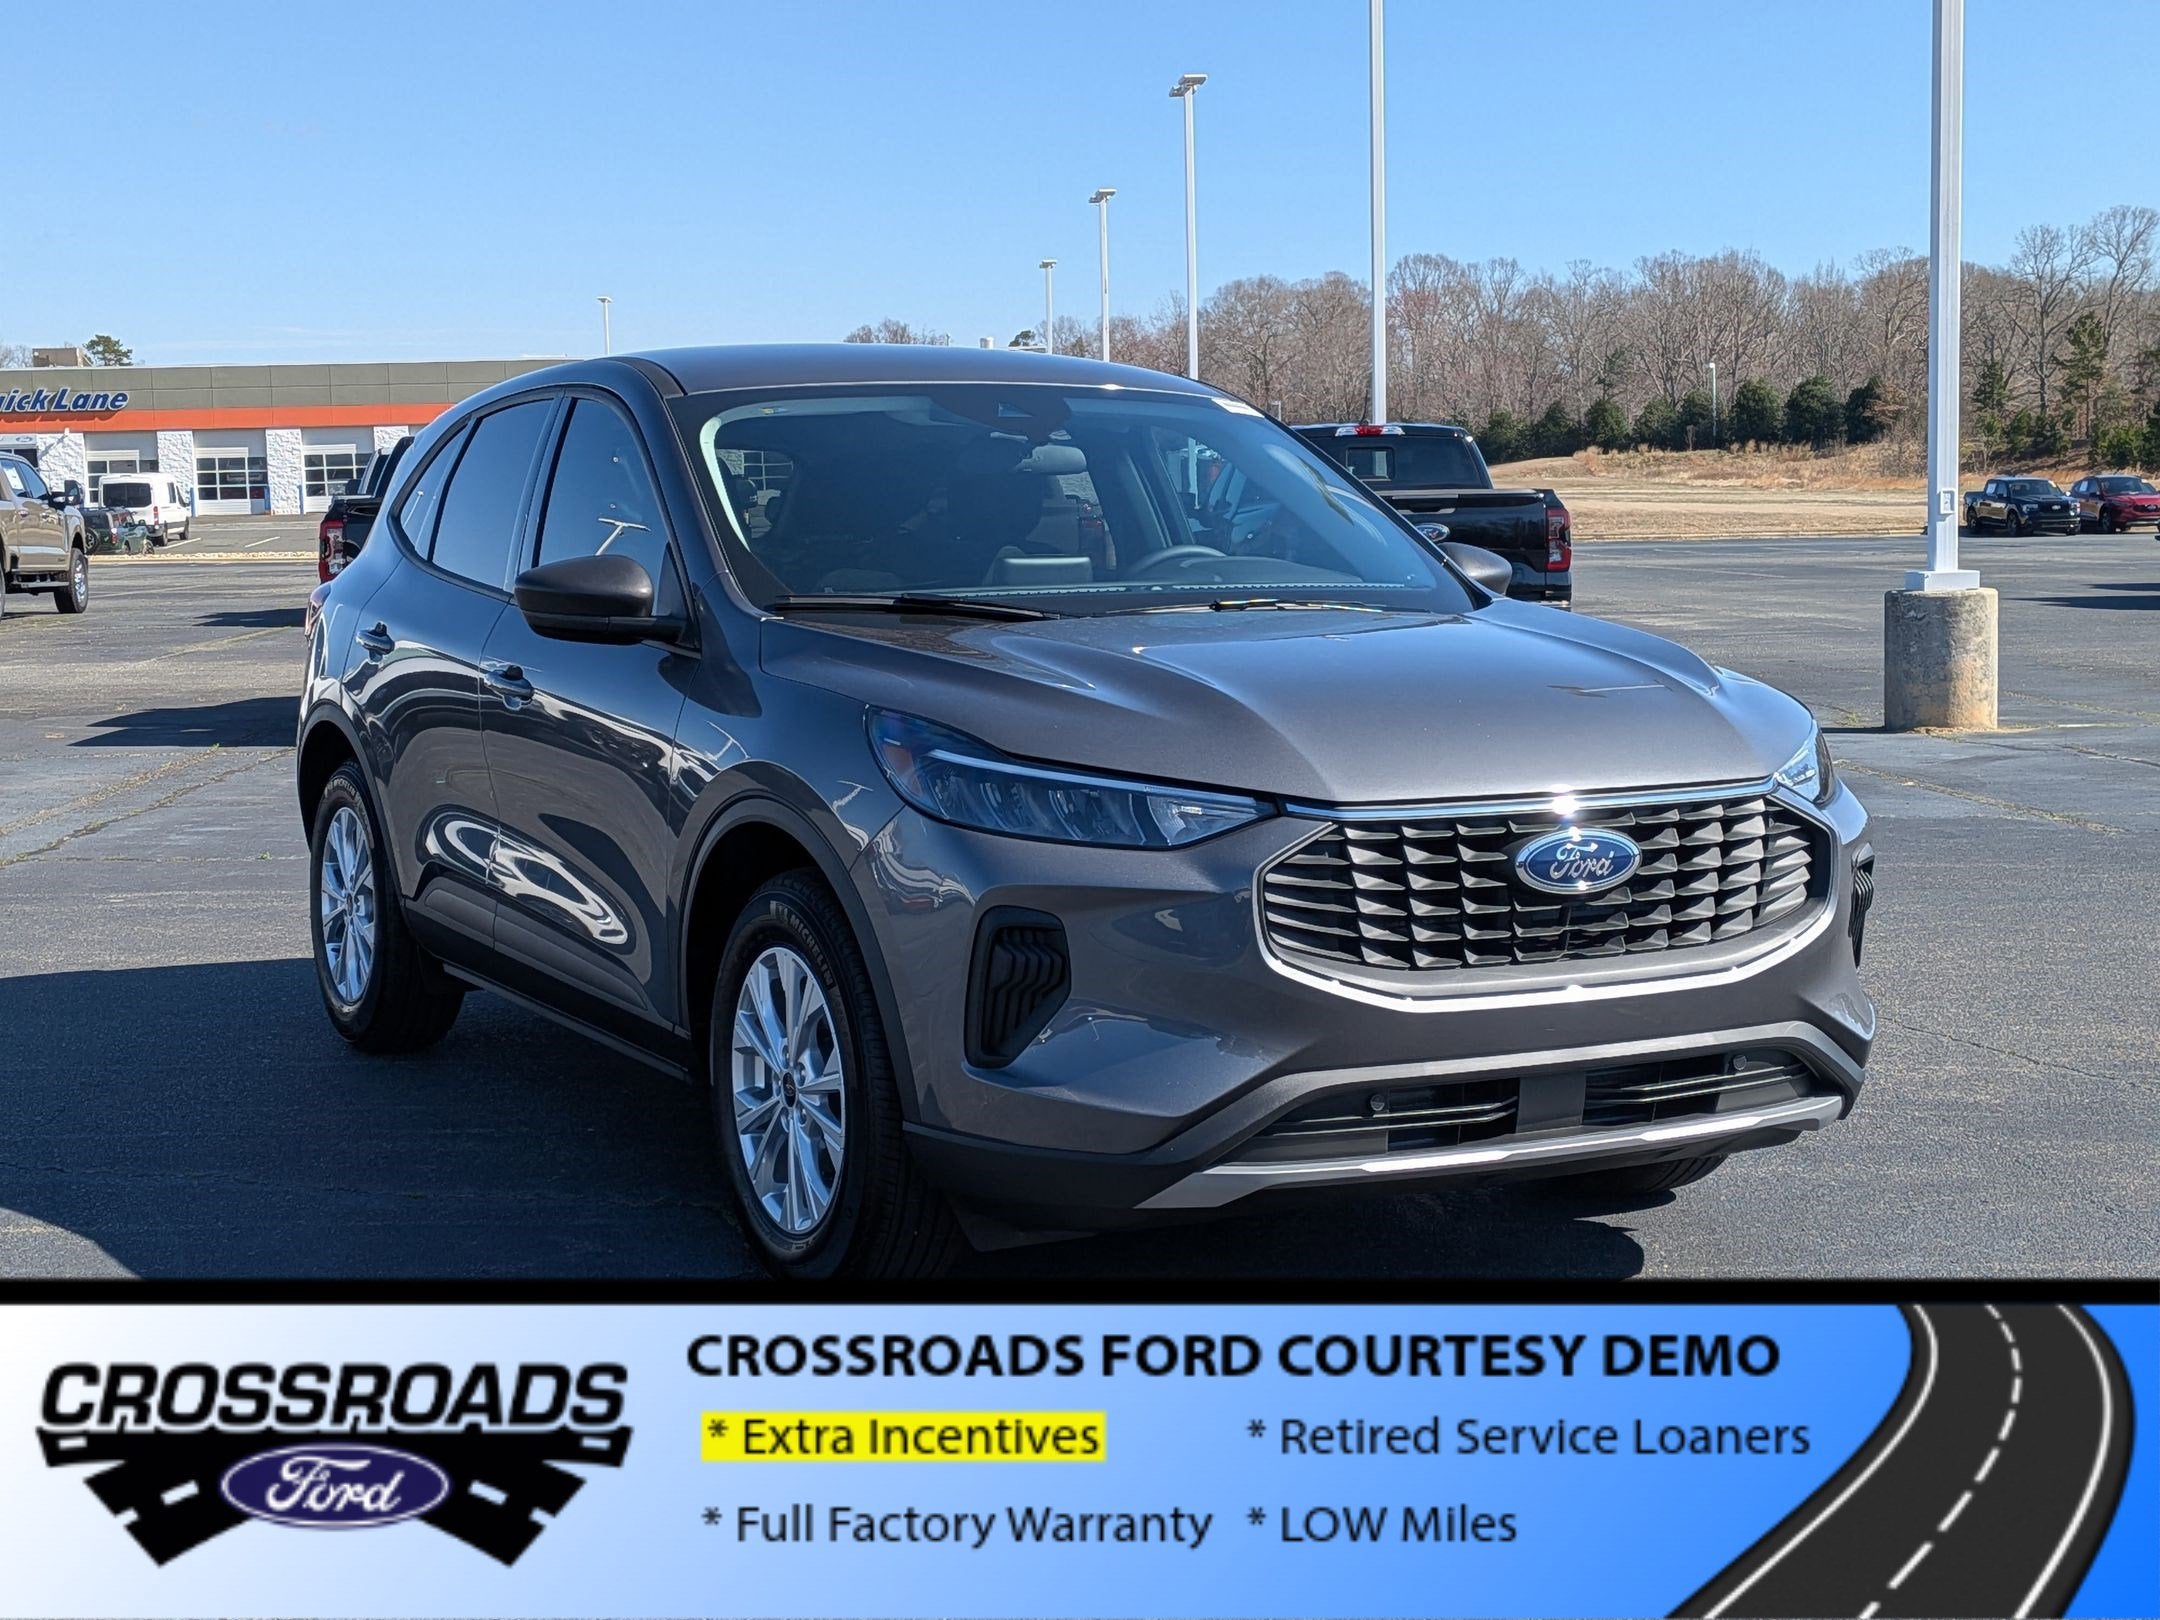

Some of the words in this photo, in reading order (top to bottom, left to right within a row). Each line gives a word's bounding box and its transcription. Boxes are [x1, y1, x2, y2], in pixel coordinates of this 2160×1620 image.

[53, 387, 128, 411] Lane
[1549, 843, 1615, 879] Ford
[790, 915, 834, 986] MICHELIN
